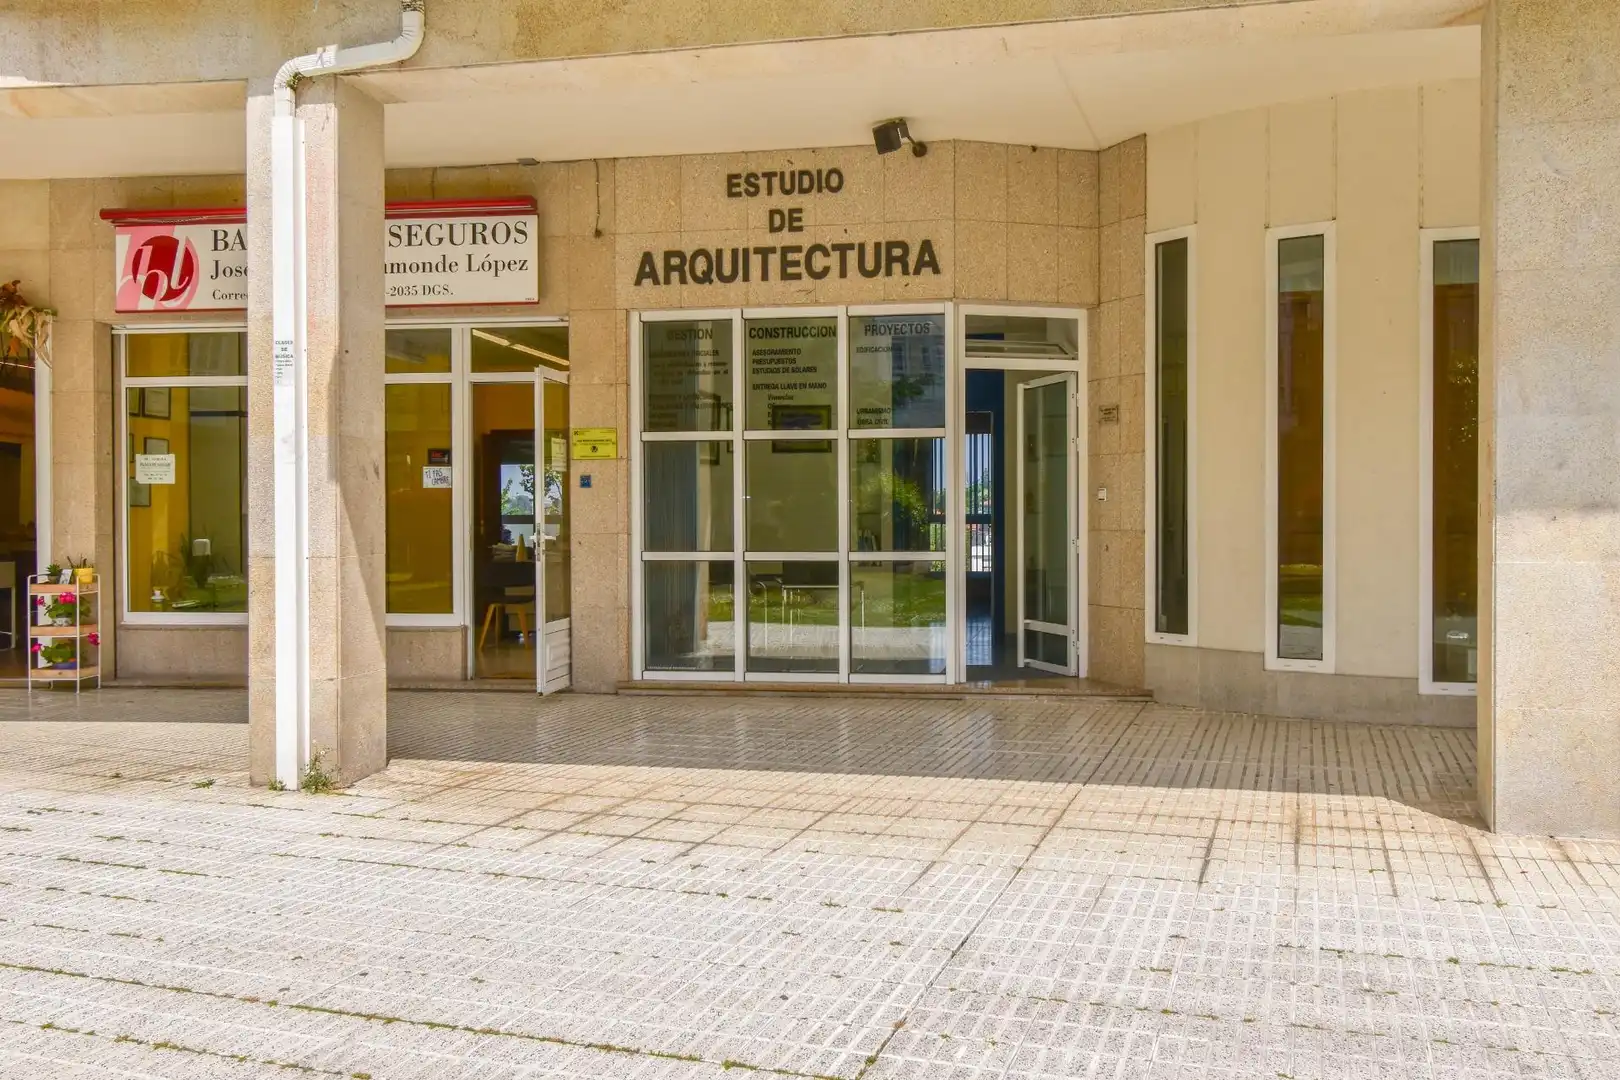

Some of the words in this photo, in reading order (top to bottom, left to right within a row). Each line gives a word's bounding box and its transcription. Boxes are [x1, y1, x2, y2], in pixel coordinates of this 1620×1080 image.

[726, 167, 844, 198] ESTUDIO
[768, 208, 804, 233] DE
[388, 221, 528, 248] SEGUROS
[466, 253, 529, 278] López
[633, 239, 941, 287] ARQUITECTURA
[422, 284, 454, 296] DGS.
[749, 325, 837, 339] CONSTRUCCION
[864, 323, 931, 337] PROYECTOS
